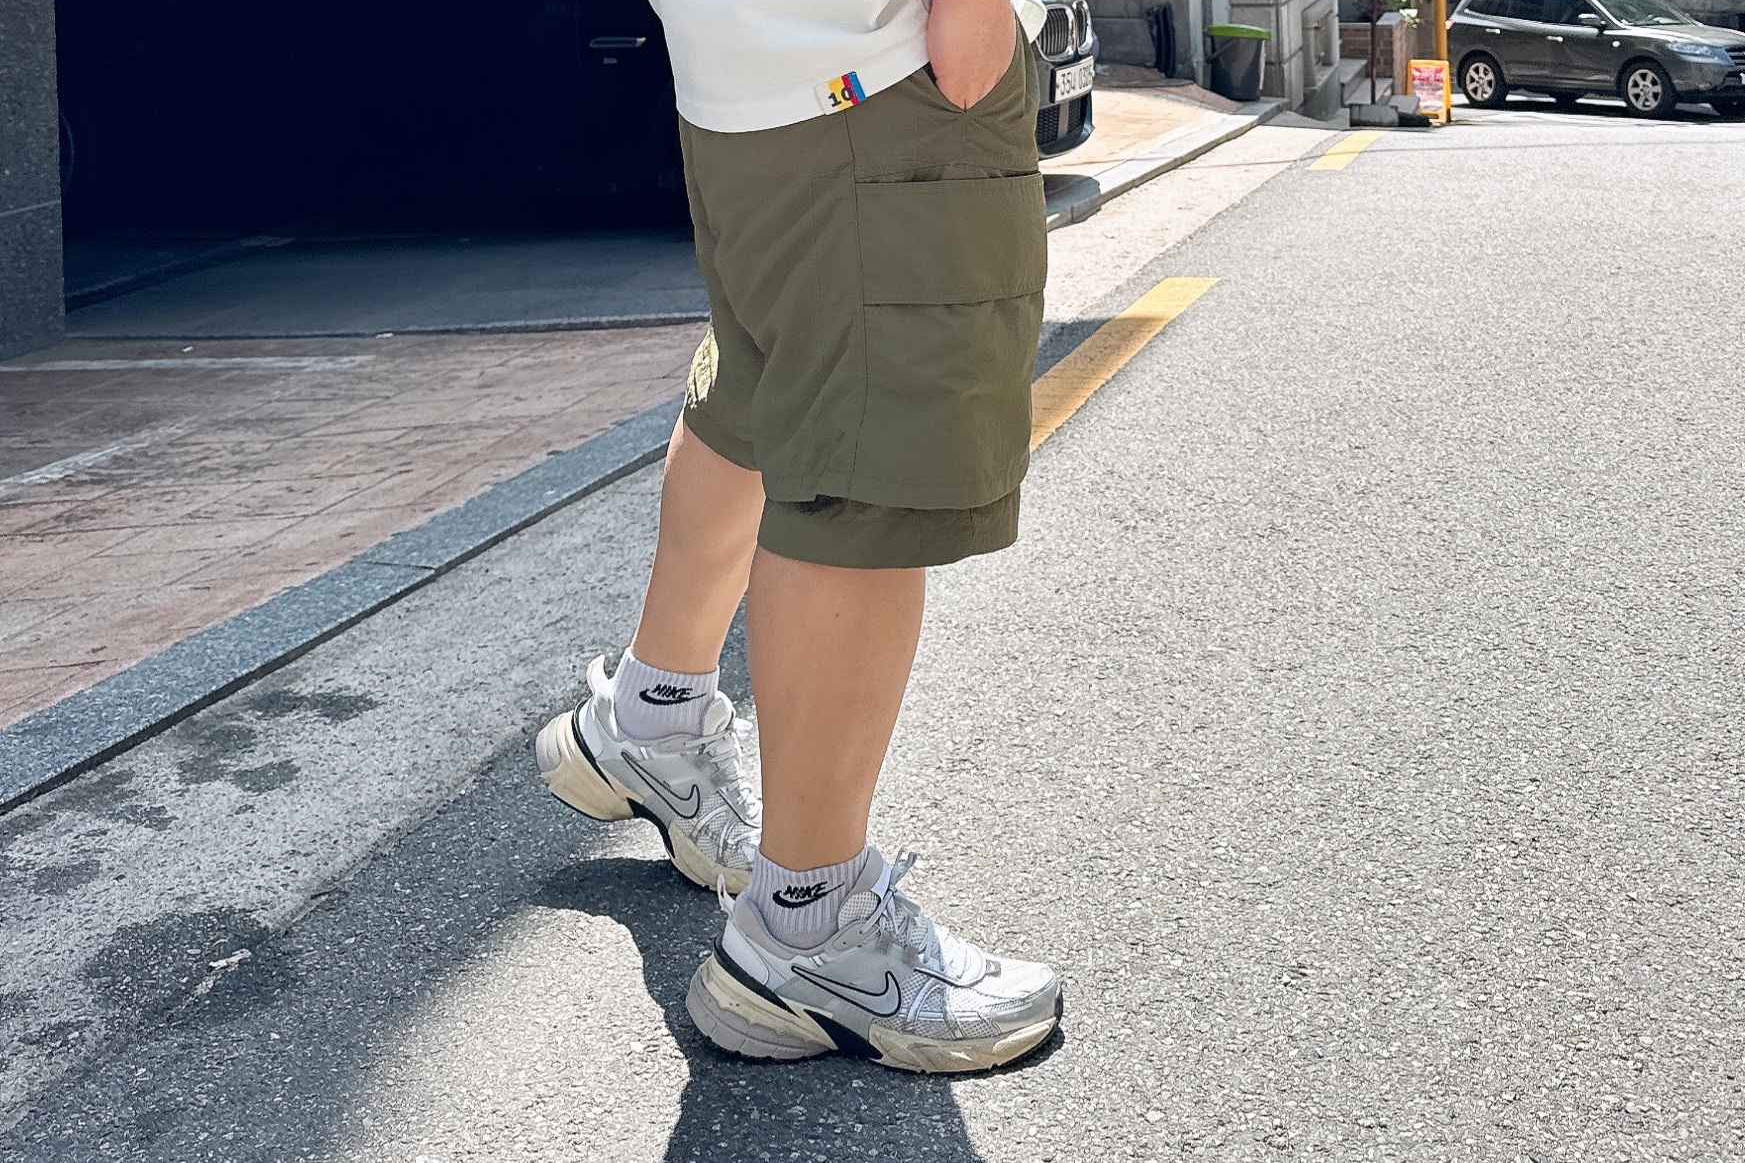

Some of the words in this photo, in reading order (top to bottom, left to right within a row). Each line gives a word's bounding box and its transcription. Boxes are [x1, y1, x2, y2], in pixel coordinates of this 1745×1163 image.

[828, 86, 853, 107] 10
[651, 683, 693, 700] NIKE
[783, 881, 828, 900] NIKE
